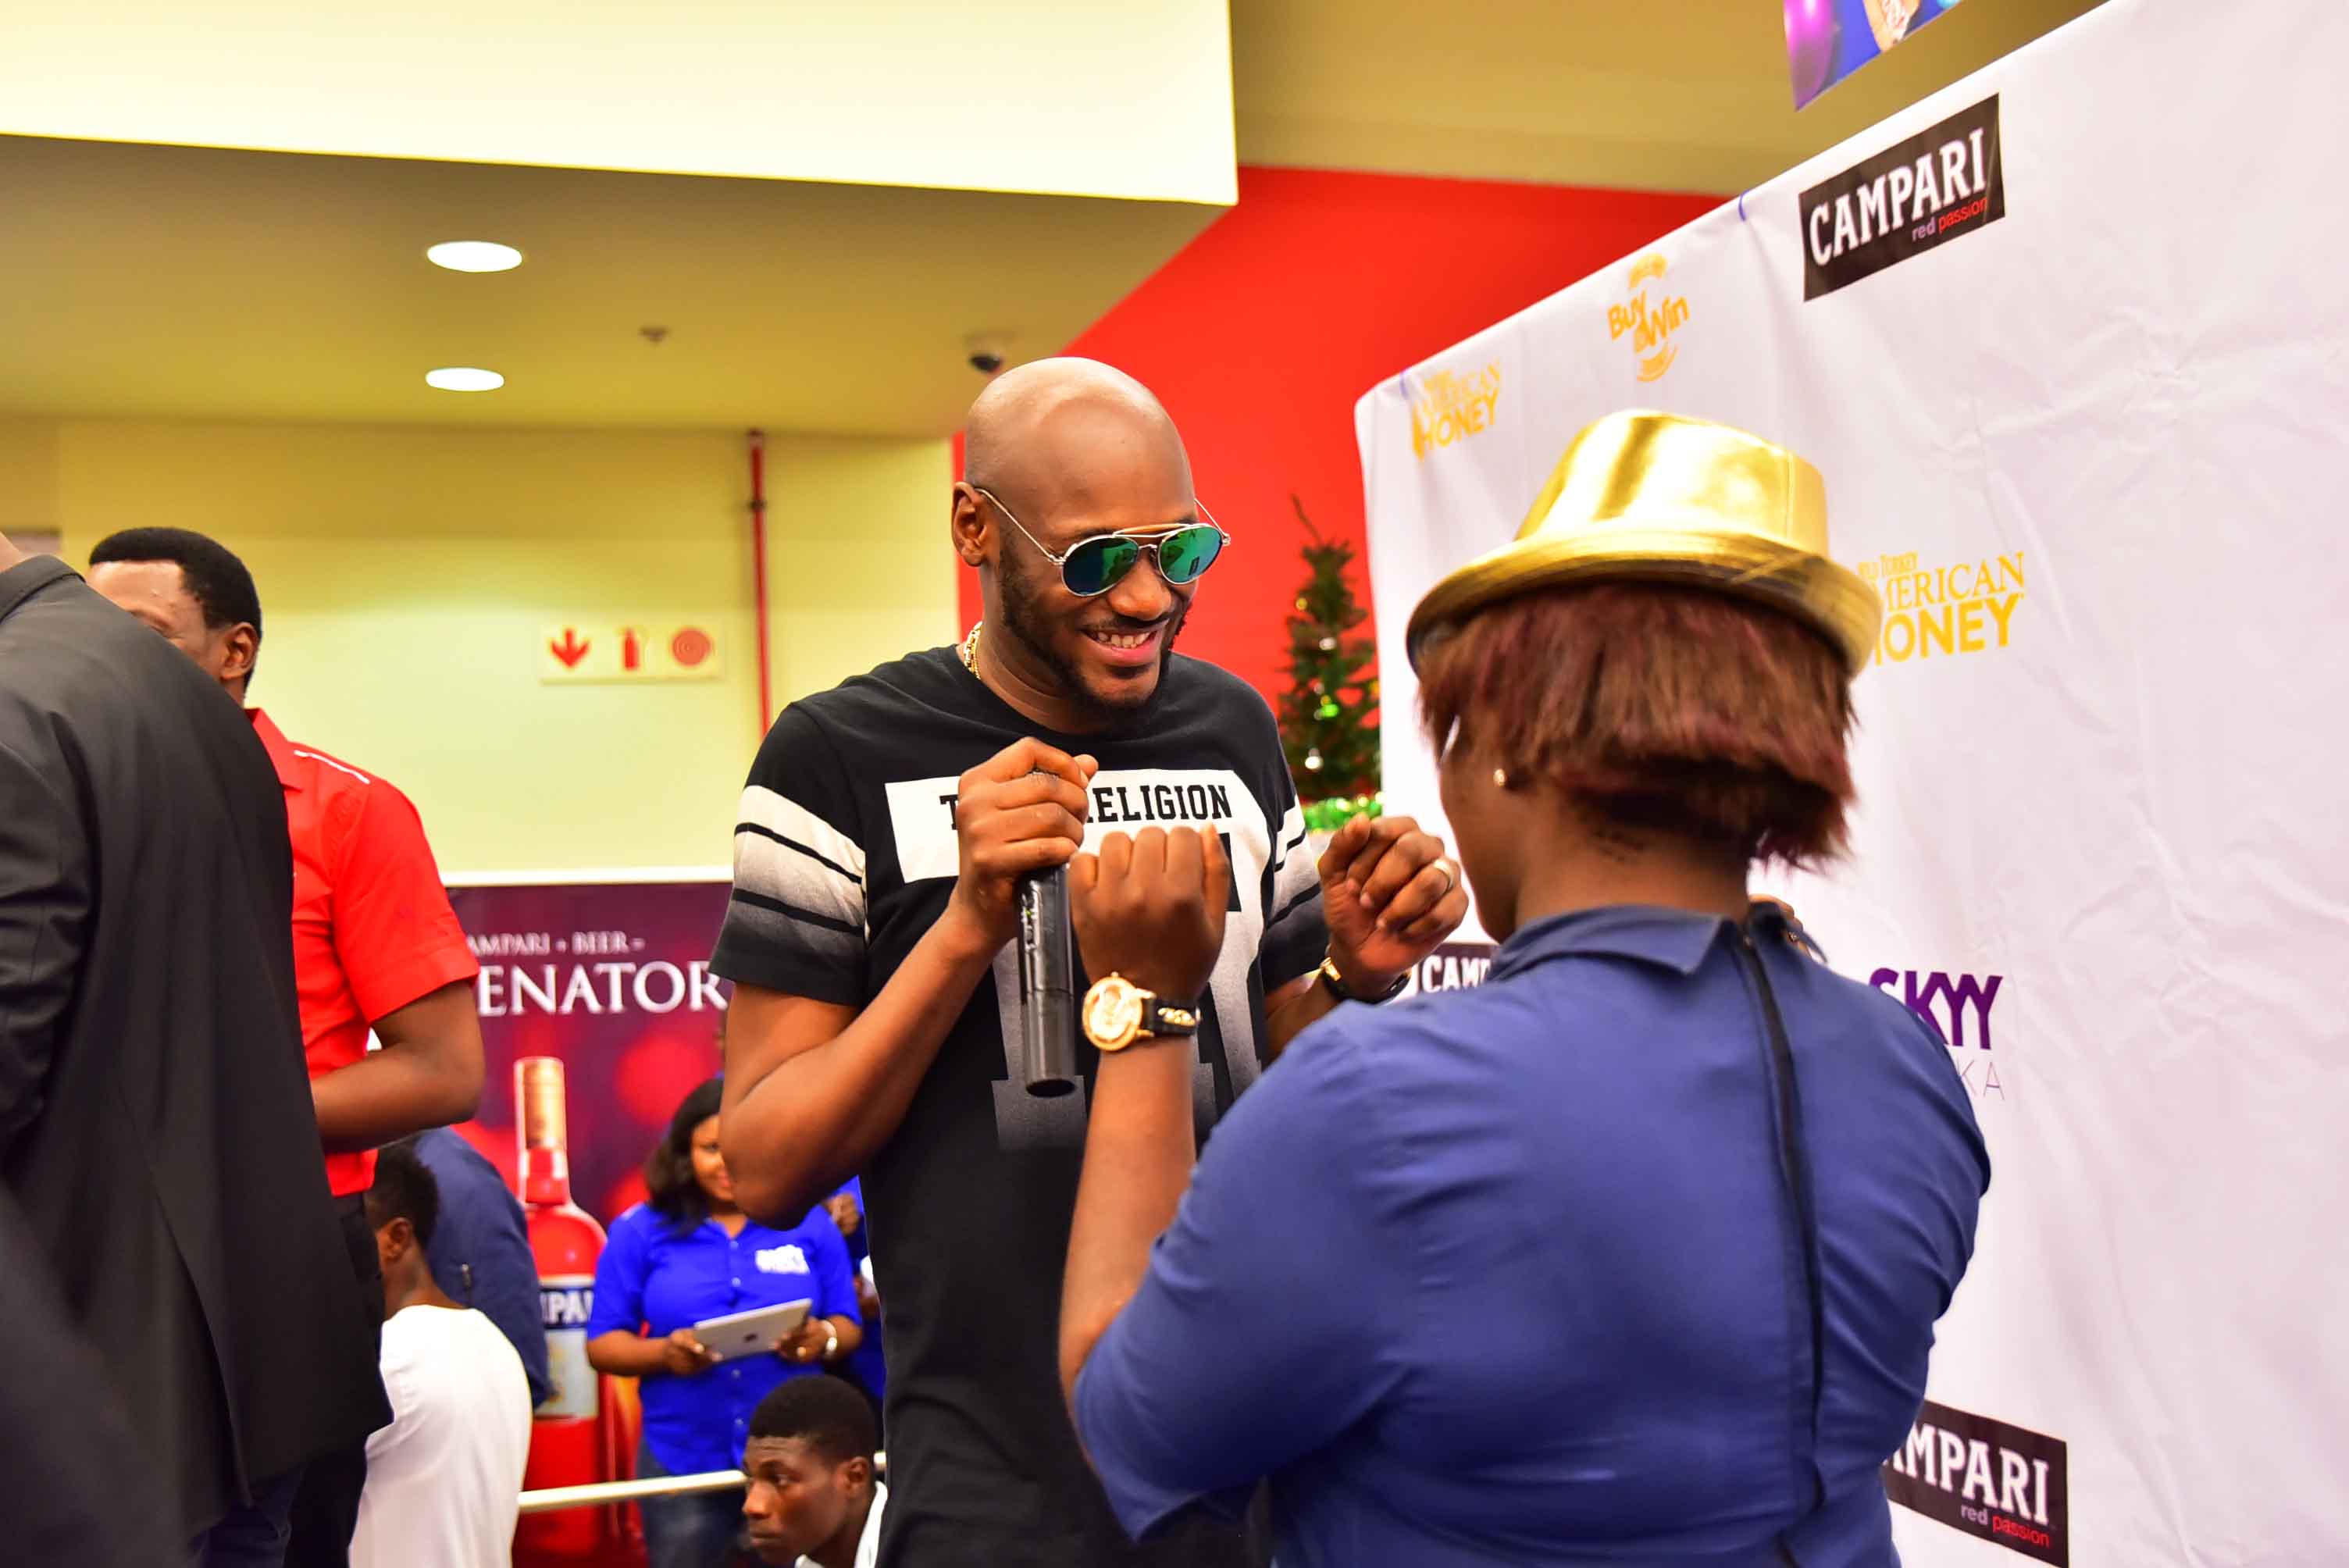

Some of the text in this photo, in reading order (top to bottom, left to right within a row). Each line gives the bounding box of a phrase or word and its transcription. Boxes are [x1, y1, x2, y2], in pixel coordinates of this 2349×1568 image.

[1809, 127, 1987, 266] CAMPARI
[1912, 196, 1988, 241] red passion
[1886, 551, 2026, 613] ERICAN
[1087, 784, 1232, 823] ELIGION
[1883, 1423, 2050, 1527] MPARI
[1961, 1504, 2050, 1548] red passion
